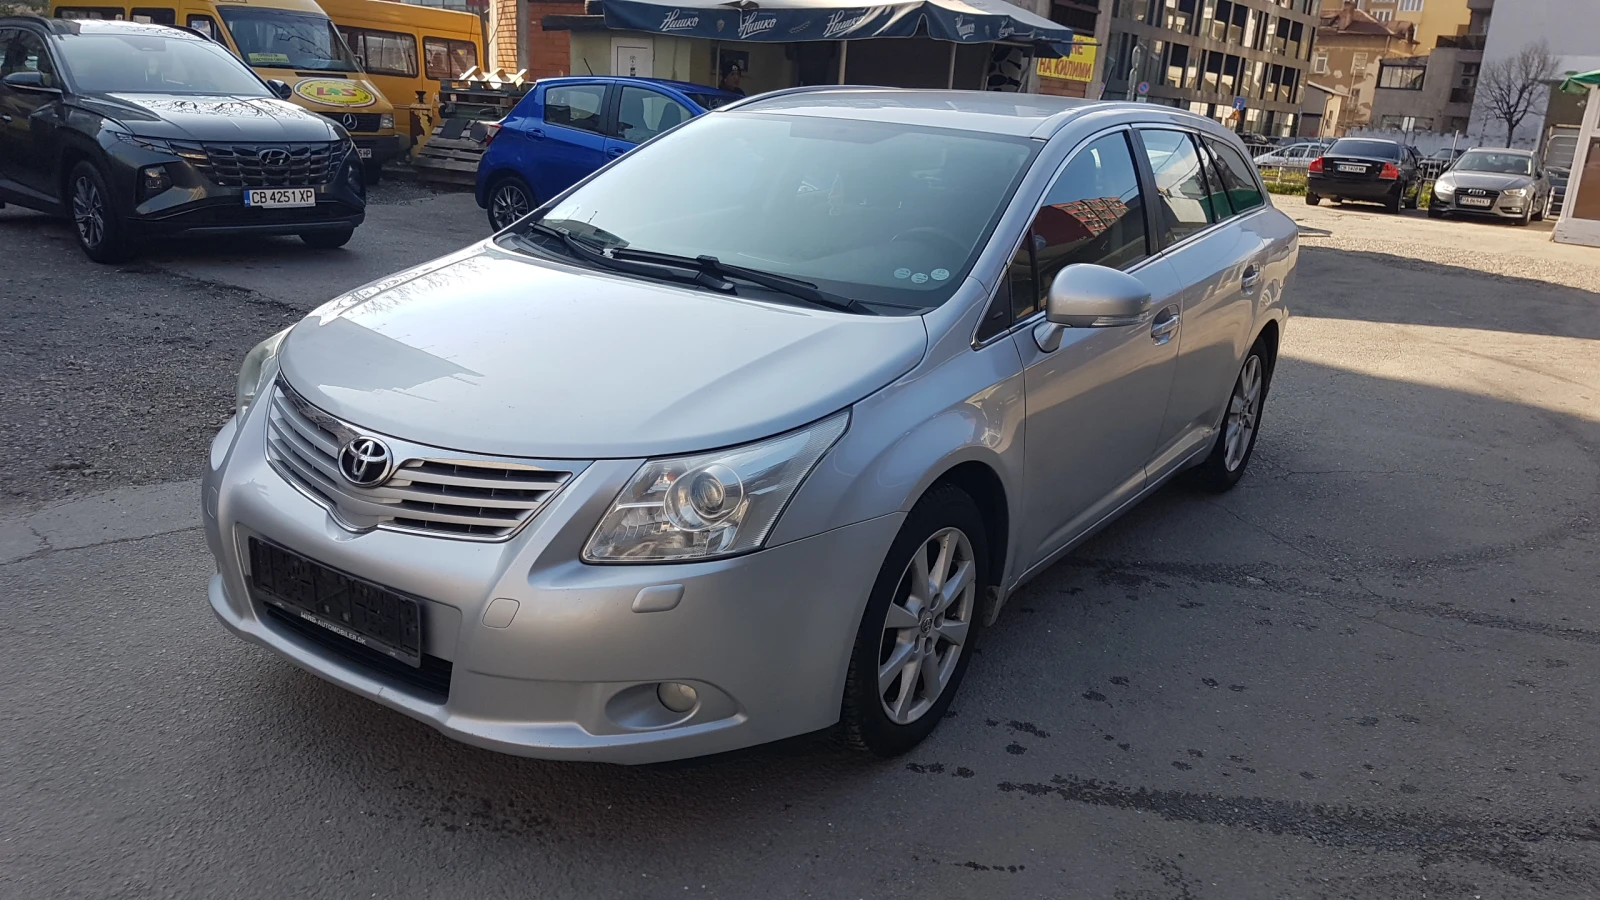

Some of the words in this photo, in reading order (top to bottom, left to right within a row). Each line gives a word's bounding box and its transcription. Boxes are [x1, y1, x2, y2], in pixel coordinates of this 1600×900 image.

[1039, 58, 1052, 73] НА
[1053, 59, 1092, 79] КИЛИМИ
[270, 190, 296, 203] 4251
